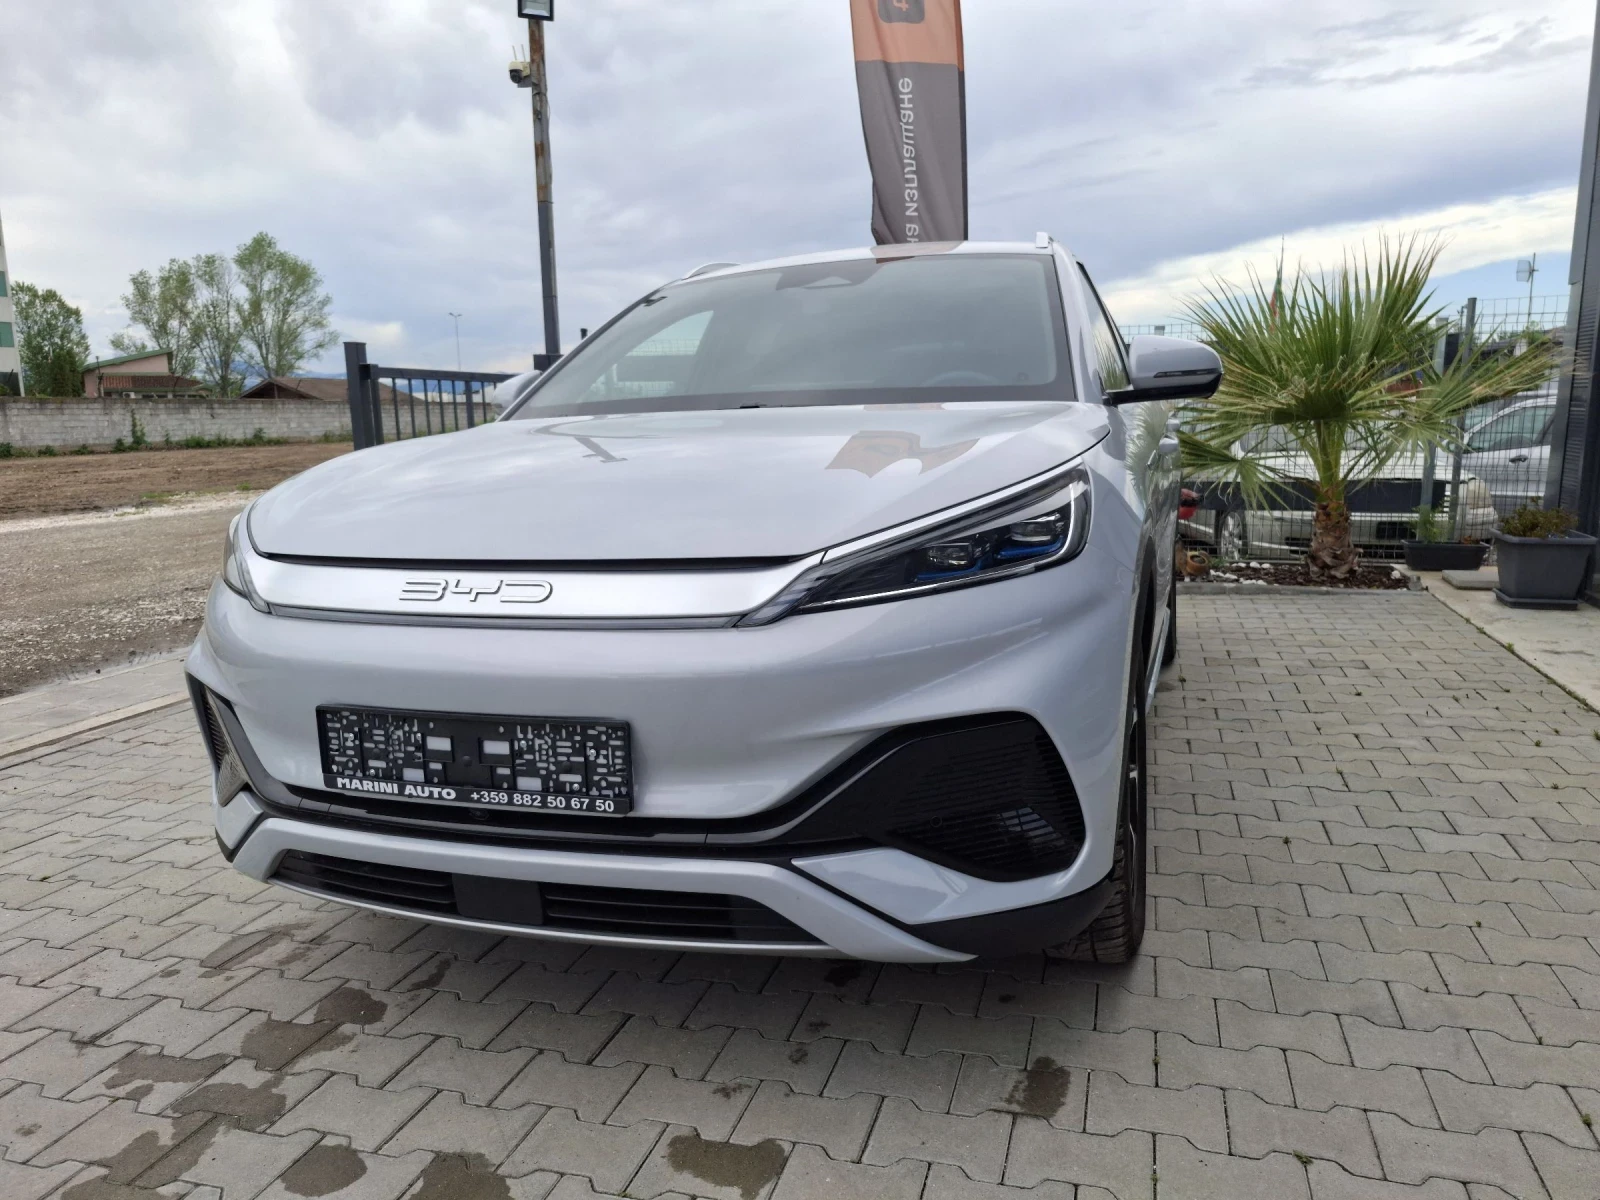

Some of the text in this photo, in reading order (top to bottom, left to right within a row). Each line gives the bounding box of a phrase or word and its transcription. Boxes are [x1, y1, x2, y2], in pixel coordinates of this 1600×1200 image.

[399, 578, 553, 603] BYD
[337, 777, 615, 813] MARINI AUTO +359 882 50 67 50
